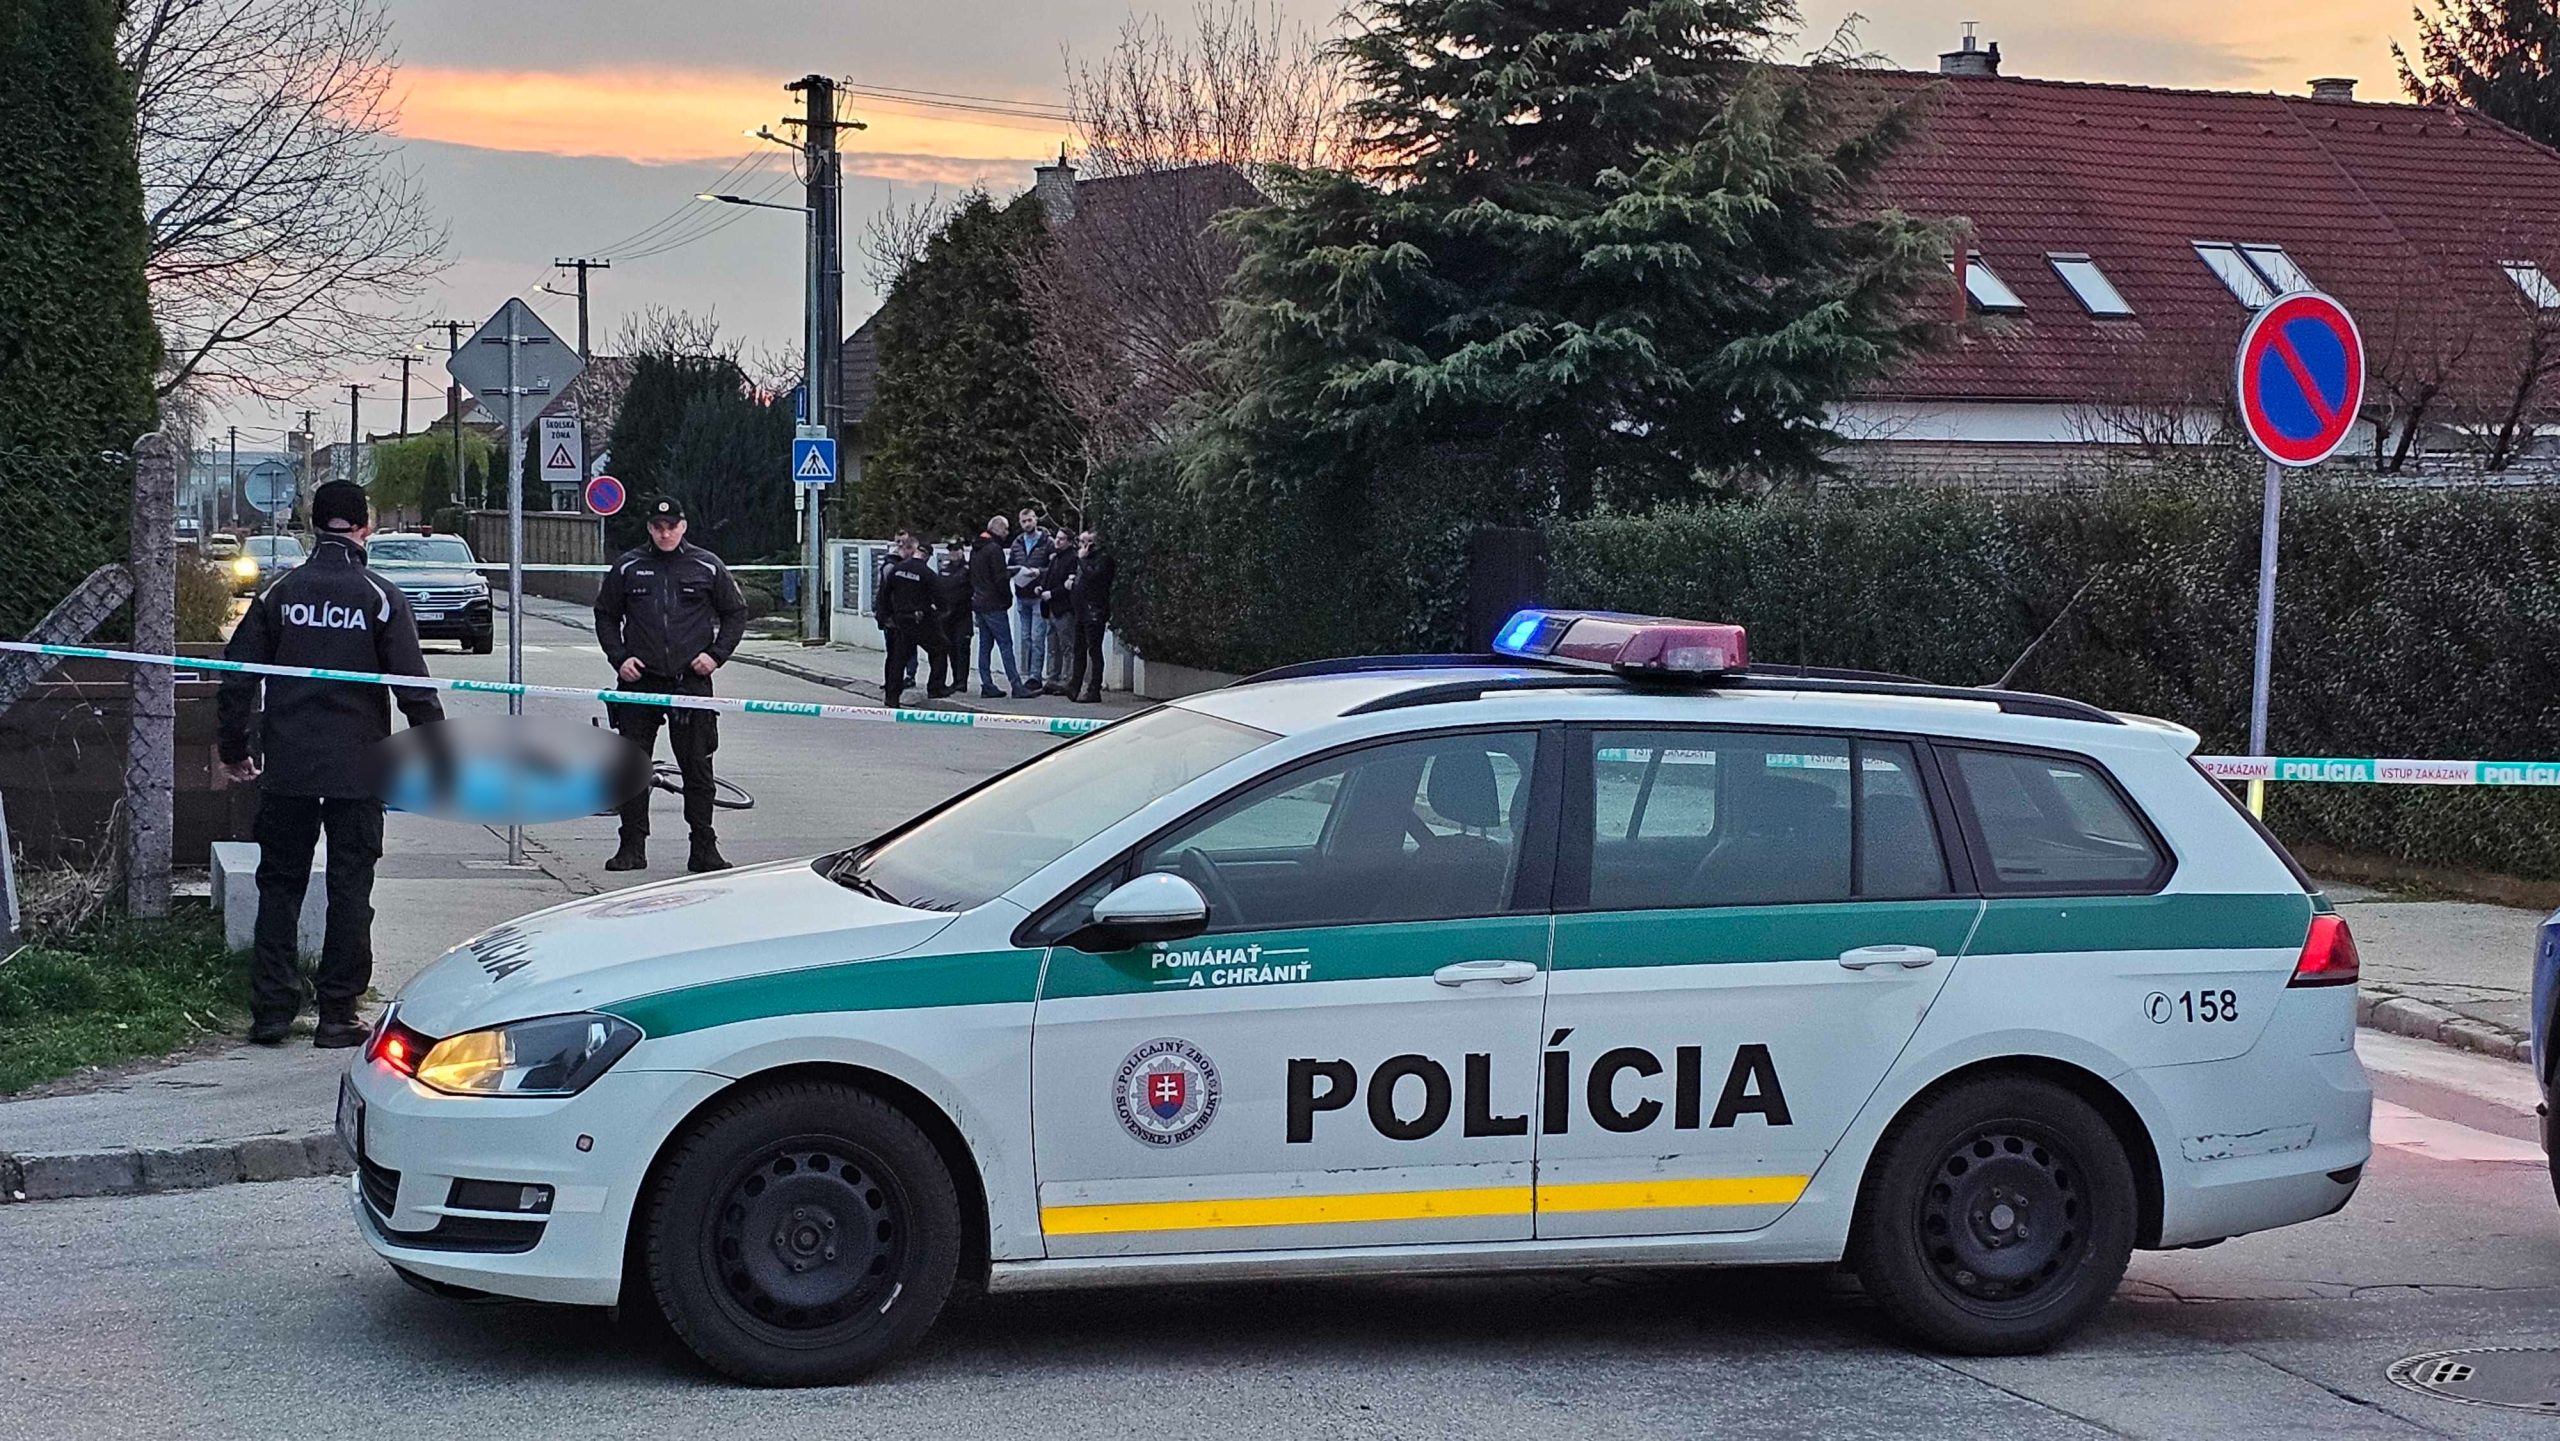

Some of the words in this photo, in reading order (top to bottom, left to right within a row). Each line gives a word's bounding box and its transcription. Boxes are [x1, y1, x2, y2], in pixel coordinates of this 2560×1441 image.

[280, 600, 367, 630] POLÍCIA
[2283, 761, 2369, 781] POLÍCIA
[2381, 767, 2413, 780] VSTUP
[1152, 943, 1263, 968] POMÁHAŤ
[1188, 971, 1205, 987] A
[1211, 961, 1312, 985] CHRÁNIŤ
[2179, 989, 2239, 1023] 158
[1117, 1040, 1185, 1085] POLICAJNÝ
[1186, 1048, 1215, 1080] ZBOR
[1286, 1027, 1794, 1144] POLÍCIA
[1116, 1095, 1172, 1145] SLOVENSKEJ
[1175, 1089, 1218, 1143] REPUBLIKY
